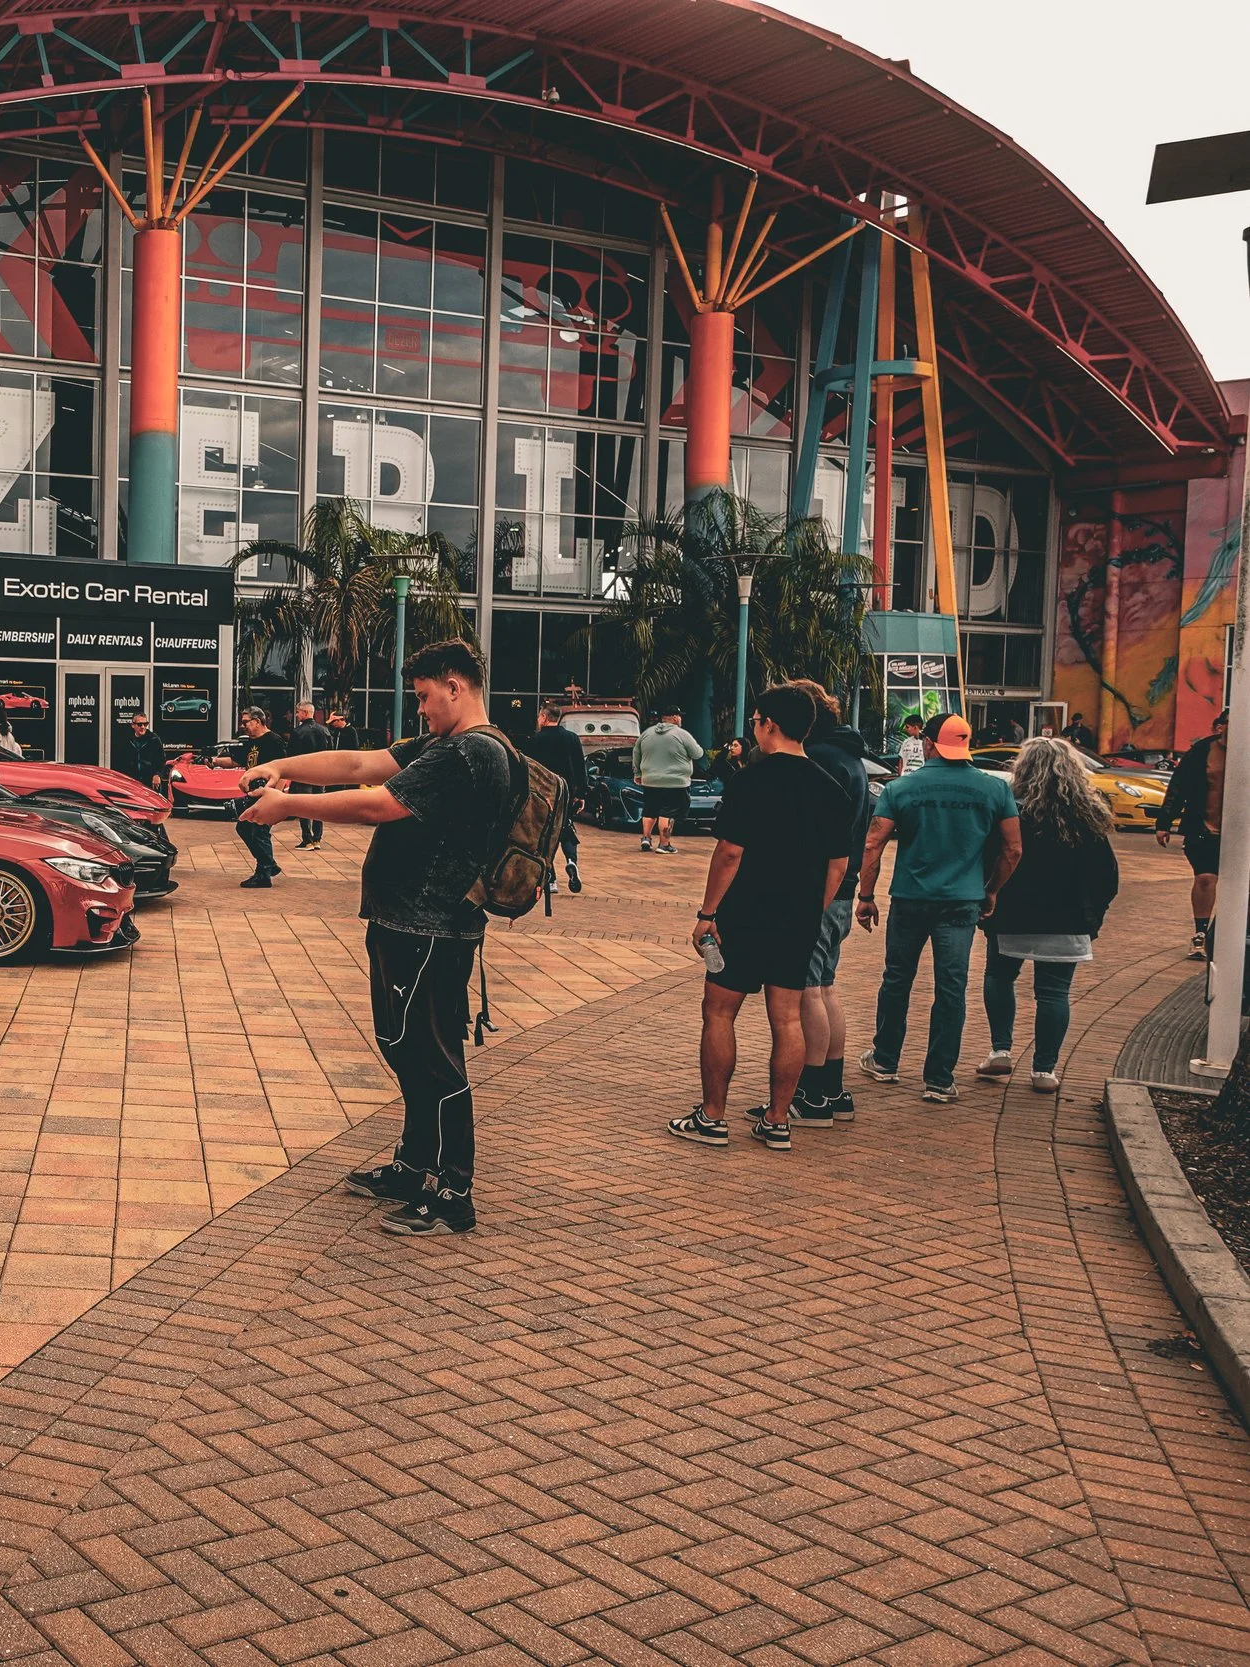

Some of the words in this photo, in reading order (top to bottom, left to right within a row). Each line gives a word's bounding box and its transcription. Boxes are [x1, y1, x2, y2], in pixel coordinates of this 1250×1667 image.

[3, 577, 80, 599] Exotic
[85, 583, 129, 602] Car
[134, 585, 208, 607] Rental
[66, 633, 96, 645] DAILY
[98, 634, 143, 647] RENTALS
[154, 637, 217, 650] CHAUFFEURS
[967, 688, 996, 696] ENTRANCE
[68, 695, 82, 708] mph
[82, 695, 95, 706] club
[114, 697, 127, 709] mph
[127, 696, 140, 707] club
